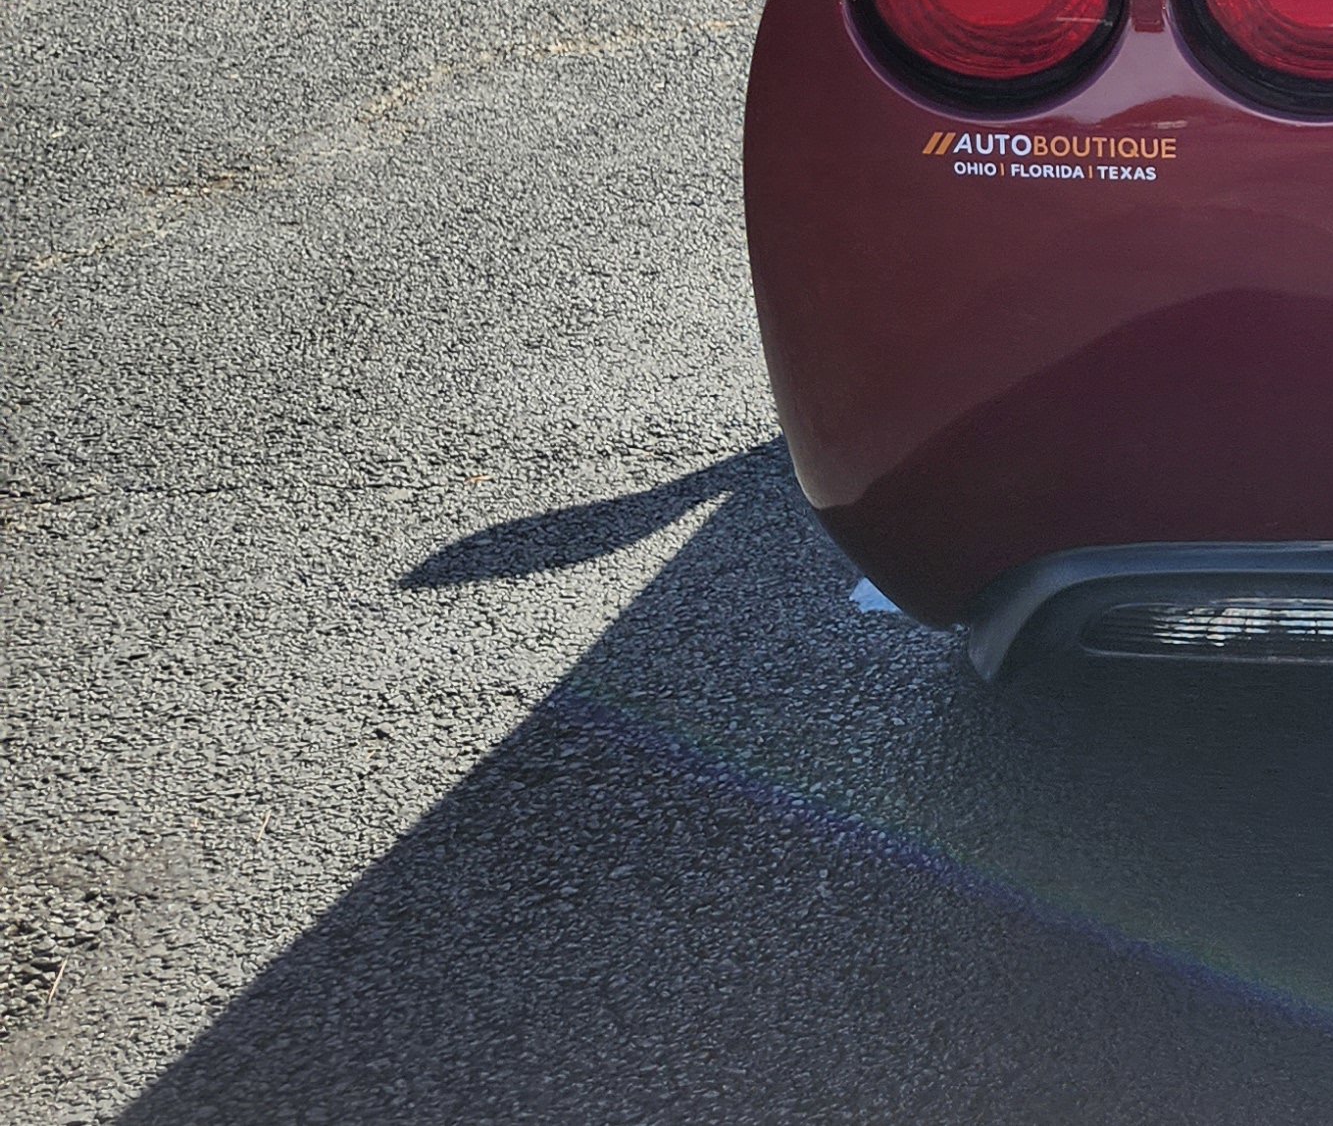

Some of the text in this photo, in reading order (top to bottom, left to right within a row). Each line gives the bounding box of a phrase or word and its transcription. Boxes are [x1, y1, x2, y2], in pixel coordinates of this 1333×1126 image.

[952, 132, 1177, 159] AUTOBOUTIQUE
[953, 161, 1158, 181] OHIO FLORIDA TEXAS
